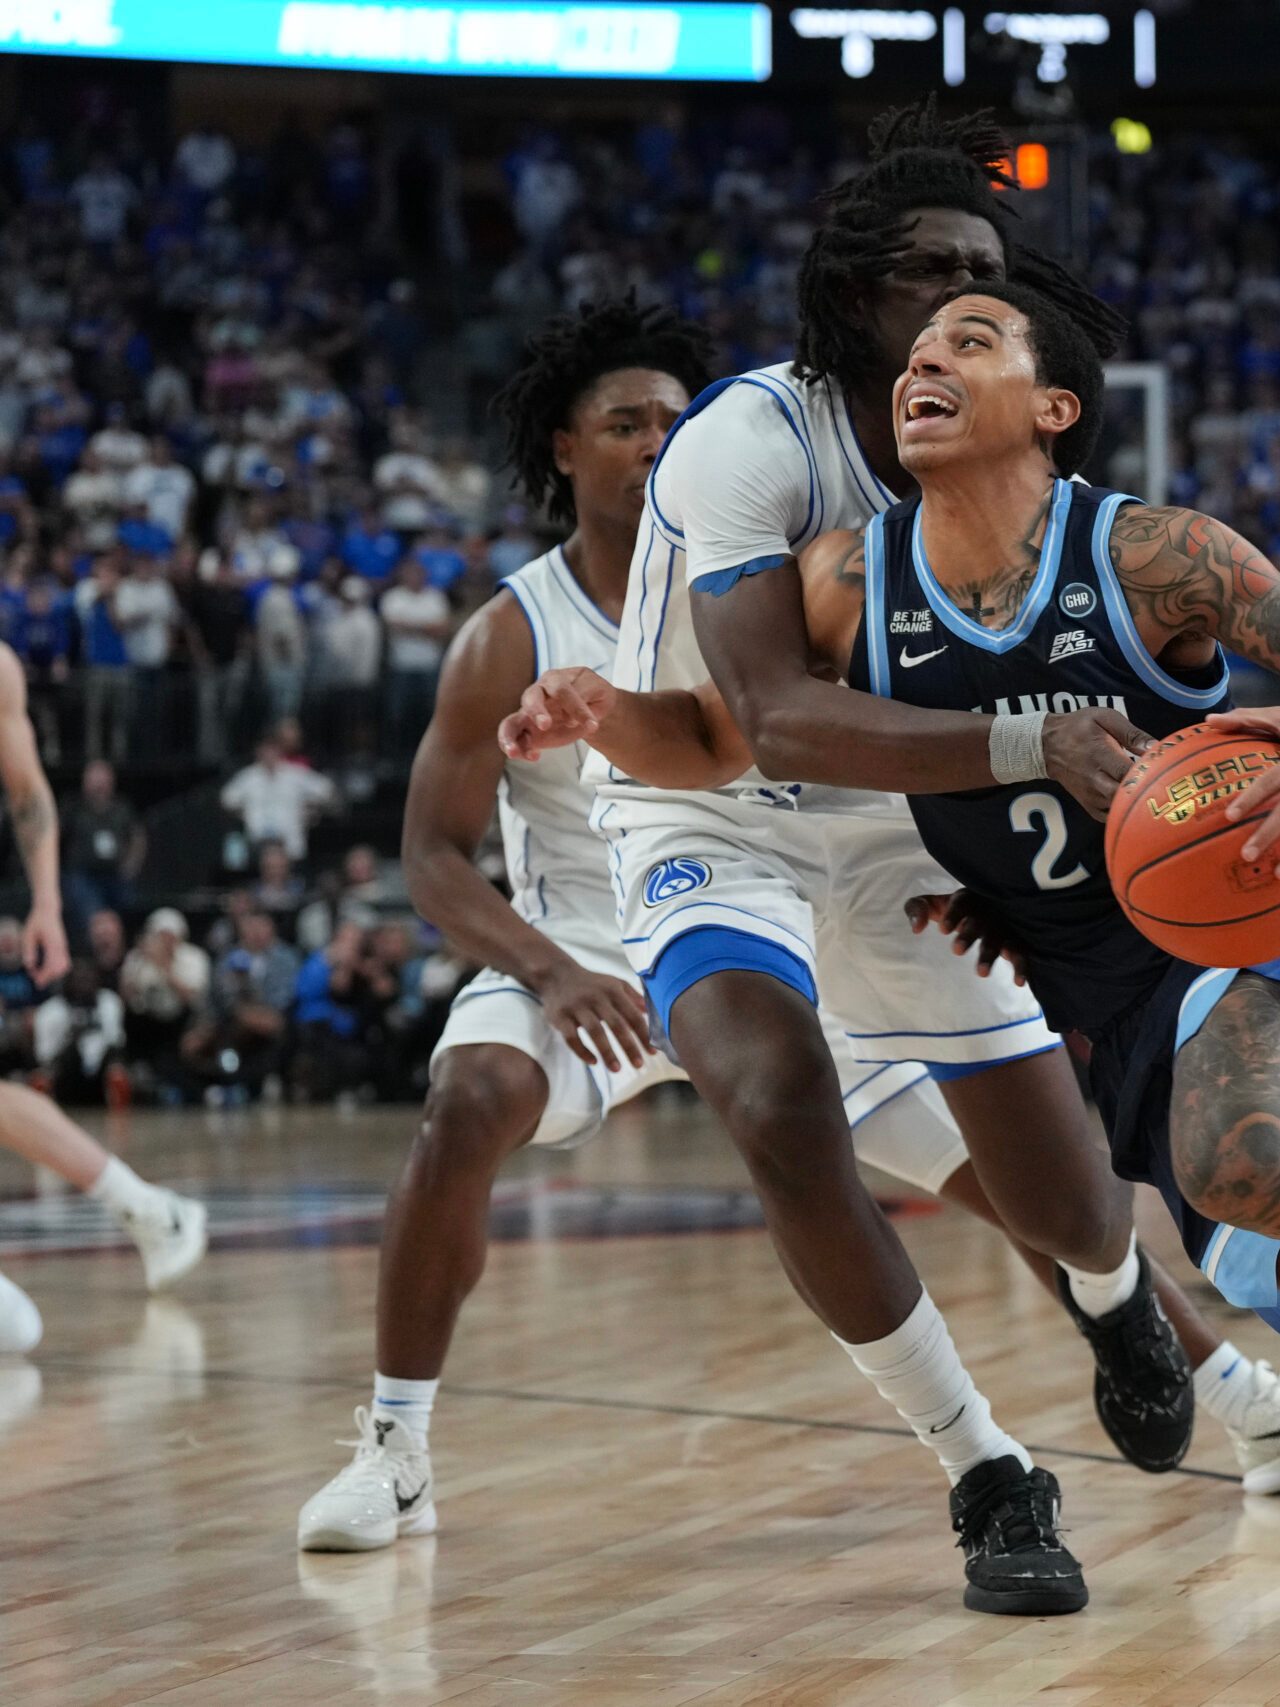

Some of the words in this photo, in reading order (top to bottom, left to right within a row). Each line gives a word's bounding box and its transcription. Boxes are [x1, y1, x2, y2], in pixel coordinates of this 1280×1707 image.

[1065, 592, 1090, 609] GHR
[893, 611, 909, 622] BE
[912, 609, 931, 622] THE
[890, 620, 932, 633] CHANGE
[1053, 630, 1085, 647] BIG
[1050, 638, 1096, 658] EAST
[1008, 791, 1091, 891] 2
